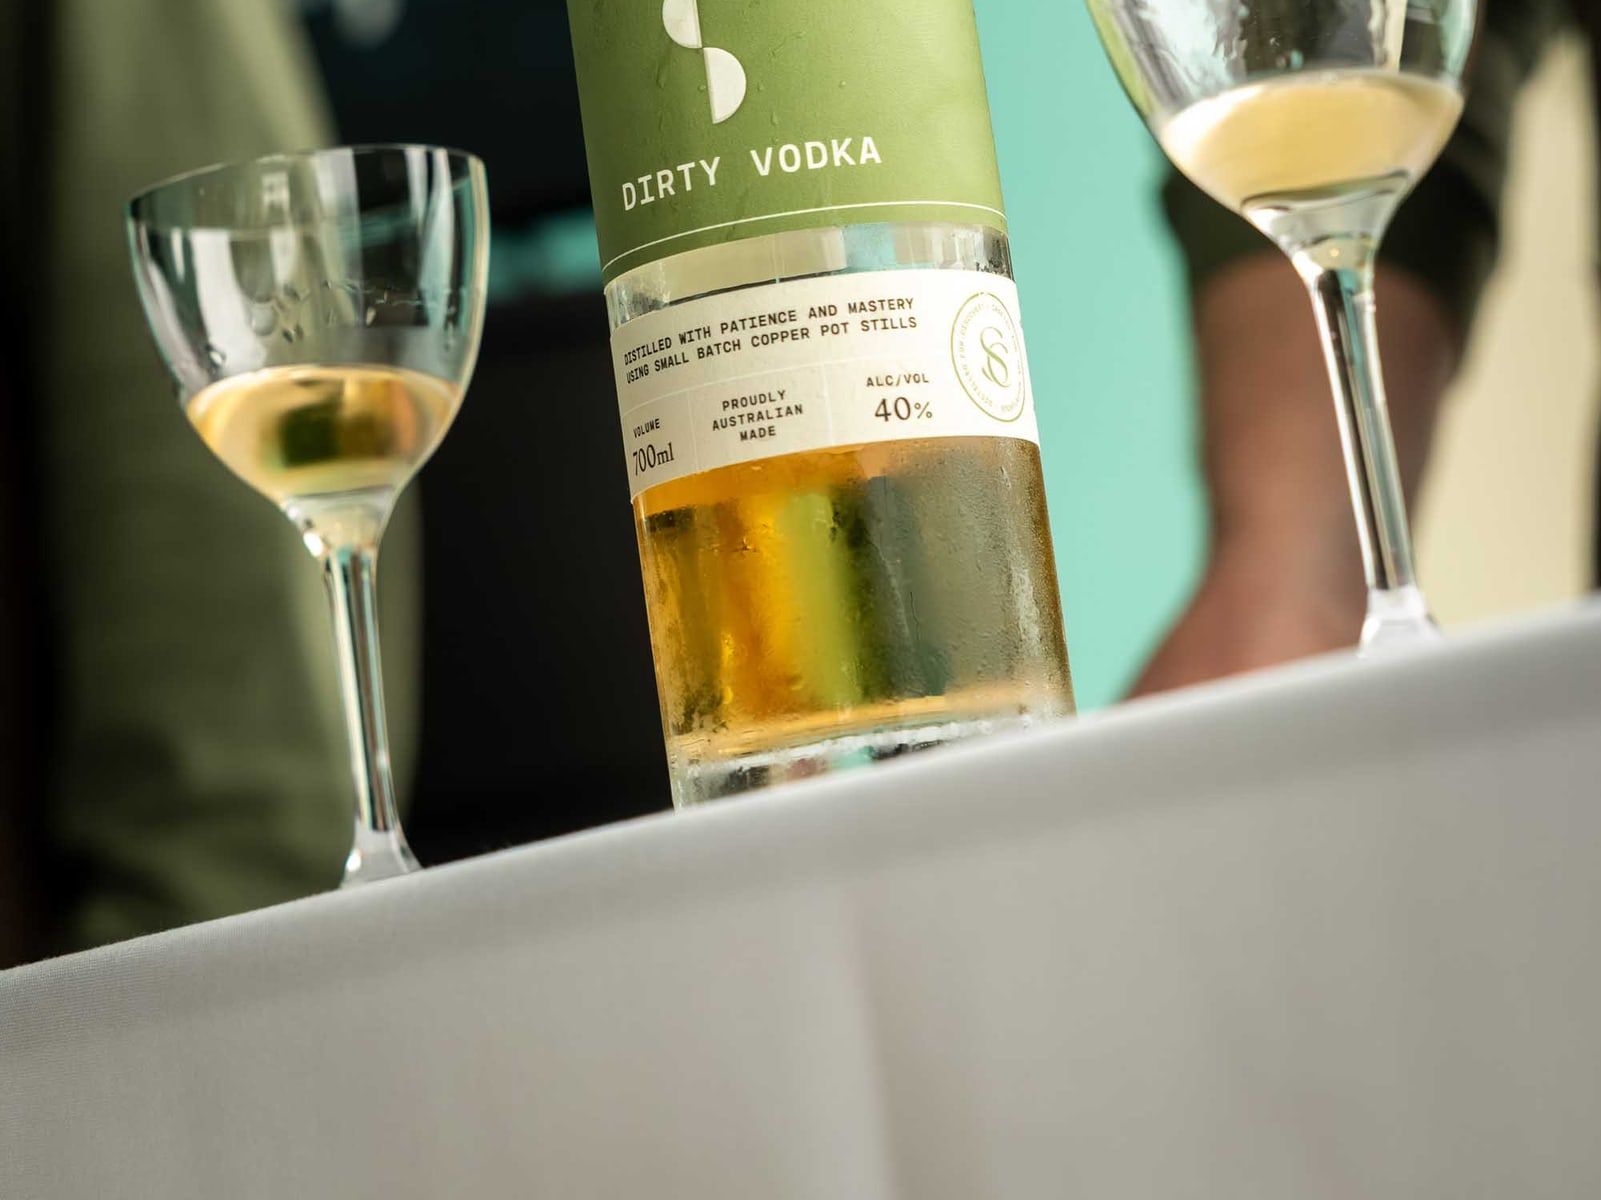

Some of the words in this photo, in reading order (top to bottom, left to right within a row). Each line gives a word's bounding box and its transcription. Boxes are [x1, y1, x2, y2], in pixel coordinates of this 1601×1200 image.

[621, 156, 721, 211] DIRTY
[750, 136, 882, 176] VODKA
[624, 337, 672, 366] DISTILLED
[678, 326, 711, 345] WITH
[720, 310, 797, 334] PATIENCE
[808, 304, 838, 319] AND
[848, 297, 914, 314] MASTERY
[626, 364, 649, 384] USING
[654, 352, 689, 372] SMALL
[697, 339, 741, 359] BATCH
[751, 327, 810, 347] COPPER
[820, 322, 849, 336] POT
[861, 316, 917, 332] STILLS
[866, 373, 929, 387] ALC/VOL
[722, 390, 786, 411] PROUDLY
[874, 396, 933, 422] 40%
[633, 418, 660, 438] VOLUME
[712, 404, 803, 431] AUSTRALIAN
[740, 425, 776, 441] MADE
[633, 442, 675, 476] 700ml
